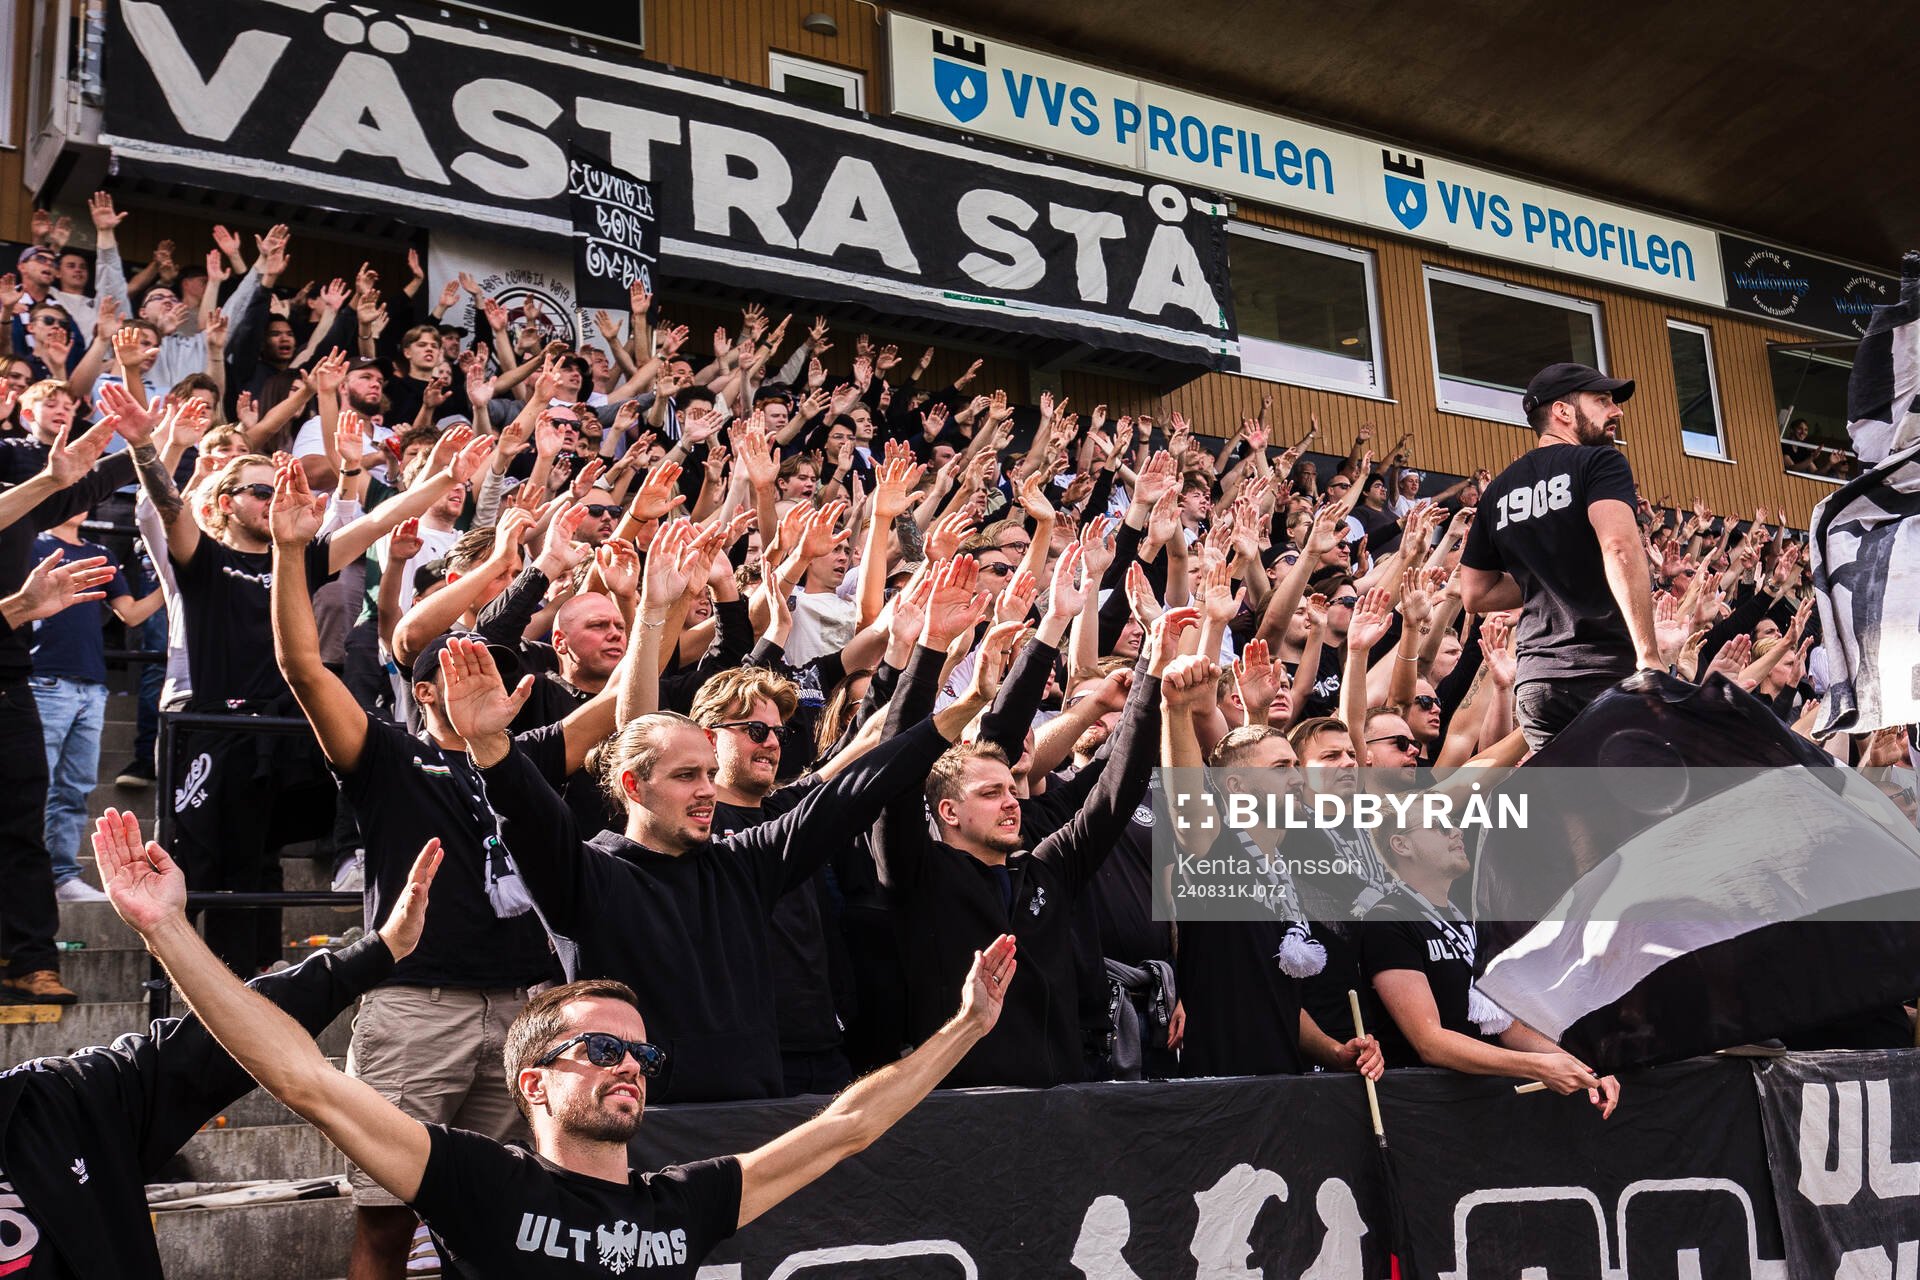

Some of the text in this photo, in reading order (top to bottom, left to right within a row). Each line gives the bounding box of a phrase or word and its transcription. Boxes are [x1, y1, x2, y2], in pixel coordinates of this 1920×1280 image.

[1002, 68, 1100, 135] VVS
[122, 1, 1228, 331] VÄSTRA STÅ
[596, 205, 642, 250] BOYS
[1437, 181, 1512, 237] VVS
[1496, 473, 1572, 531] 1908
